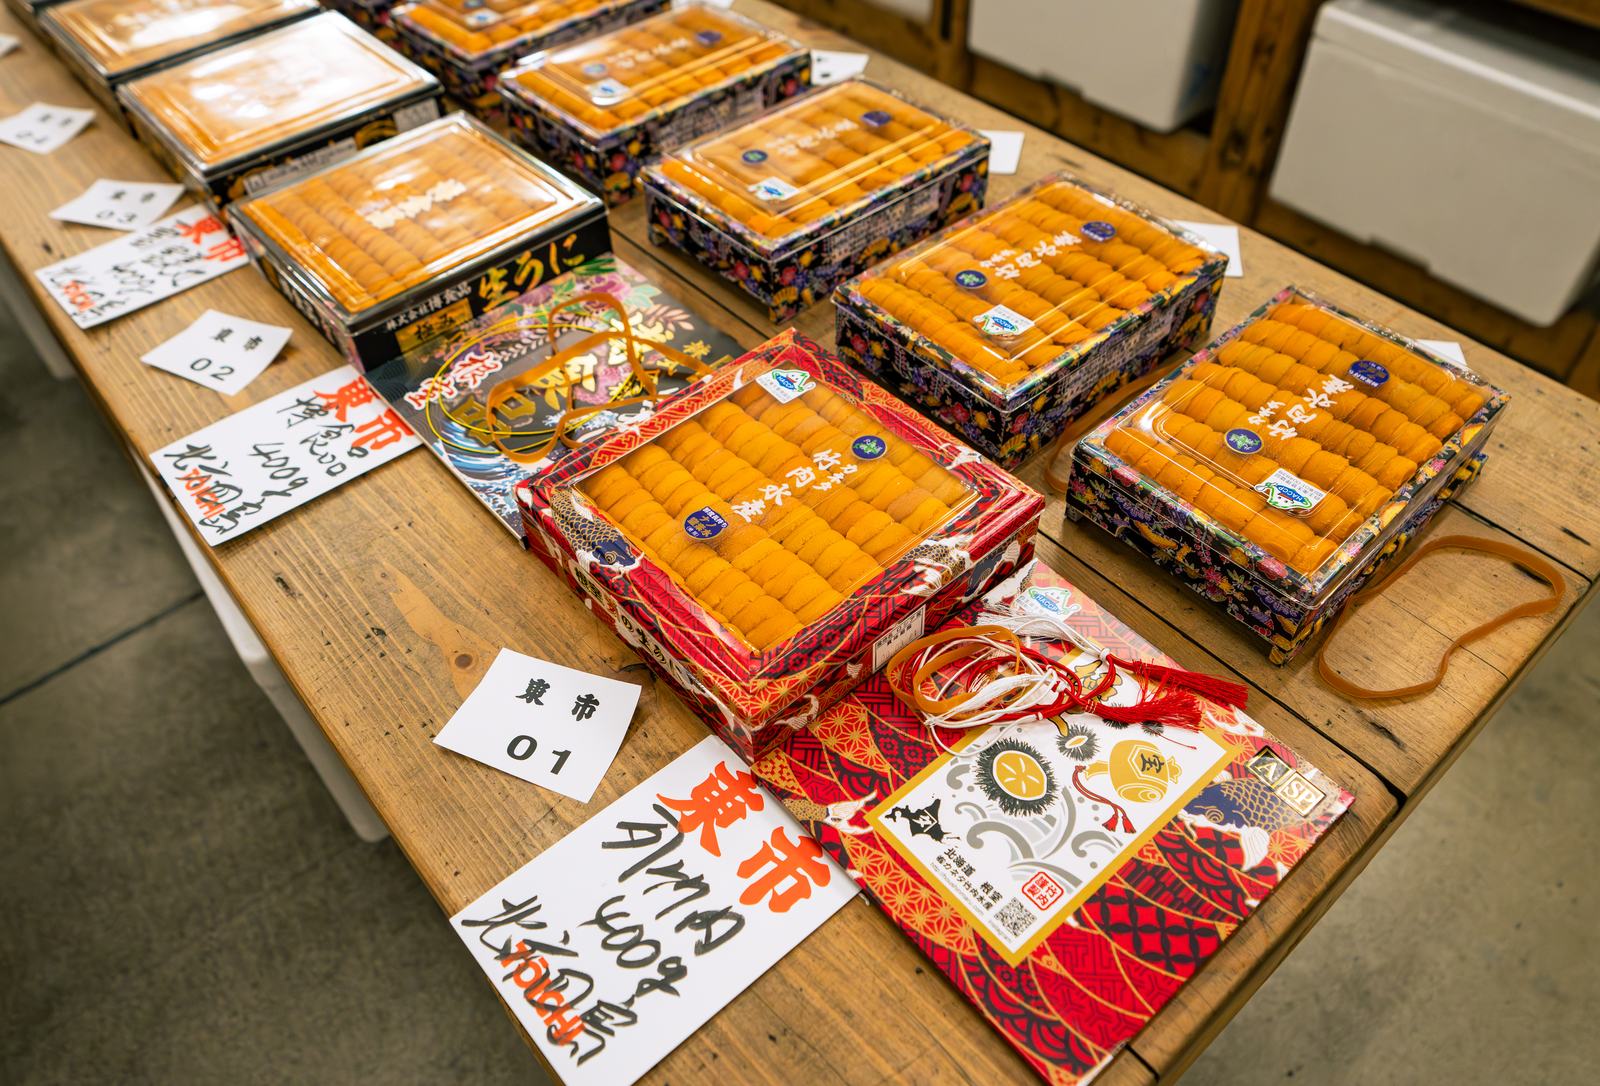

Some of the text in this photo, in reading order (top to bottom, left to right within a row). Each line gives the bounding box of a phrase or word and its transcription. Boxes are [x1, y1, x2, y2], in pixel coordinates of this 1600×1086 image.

[478, 233, 585, 312] 生うに
[189, 357, 235, 382] 02
[314, 376, 415, 452] 東市
[1277, 485, 1302, 501] HACCP
[1035, 594, 1059, 612] HACCP
[515, 678, 601, 722] 東市
[506, 734, 573, 775] 01
[656, 760, 831, 913] 東市
[944, 847, 977, 877] 北海道
[577, 895, 688, 998] 400g
